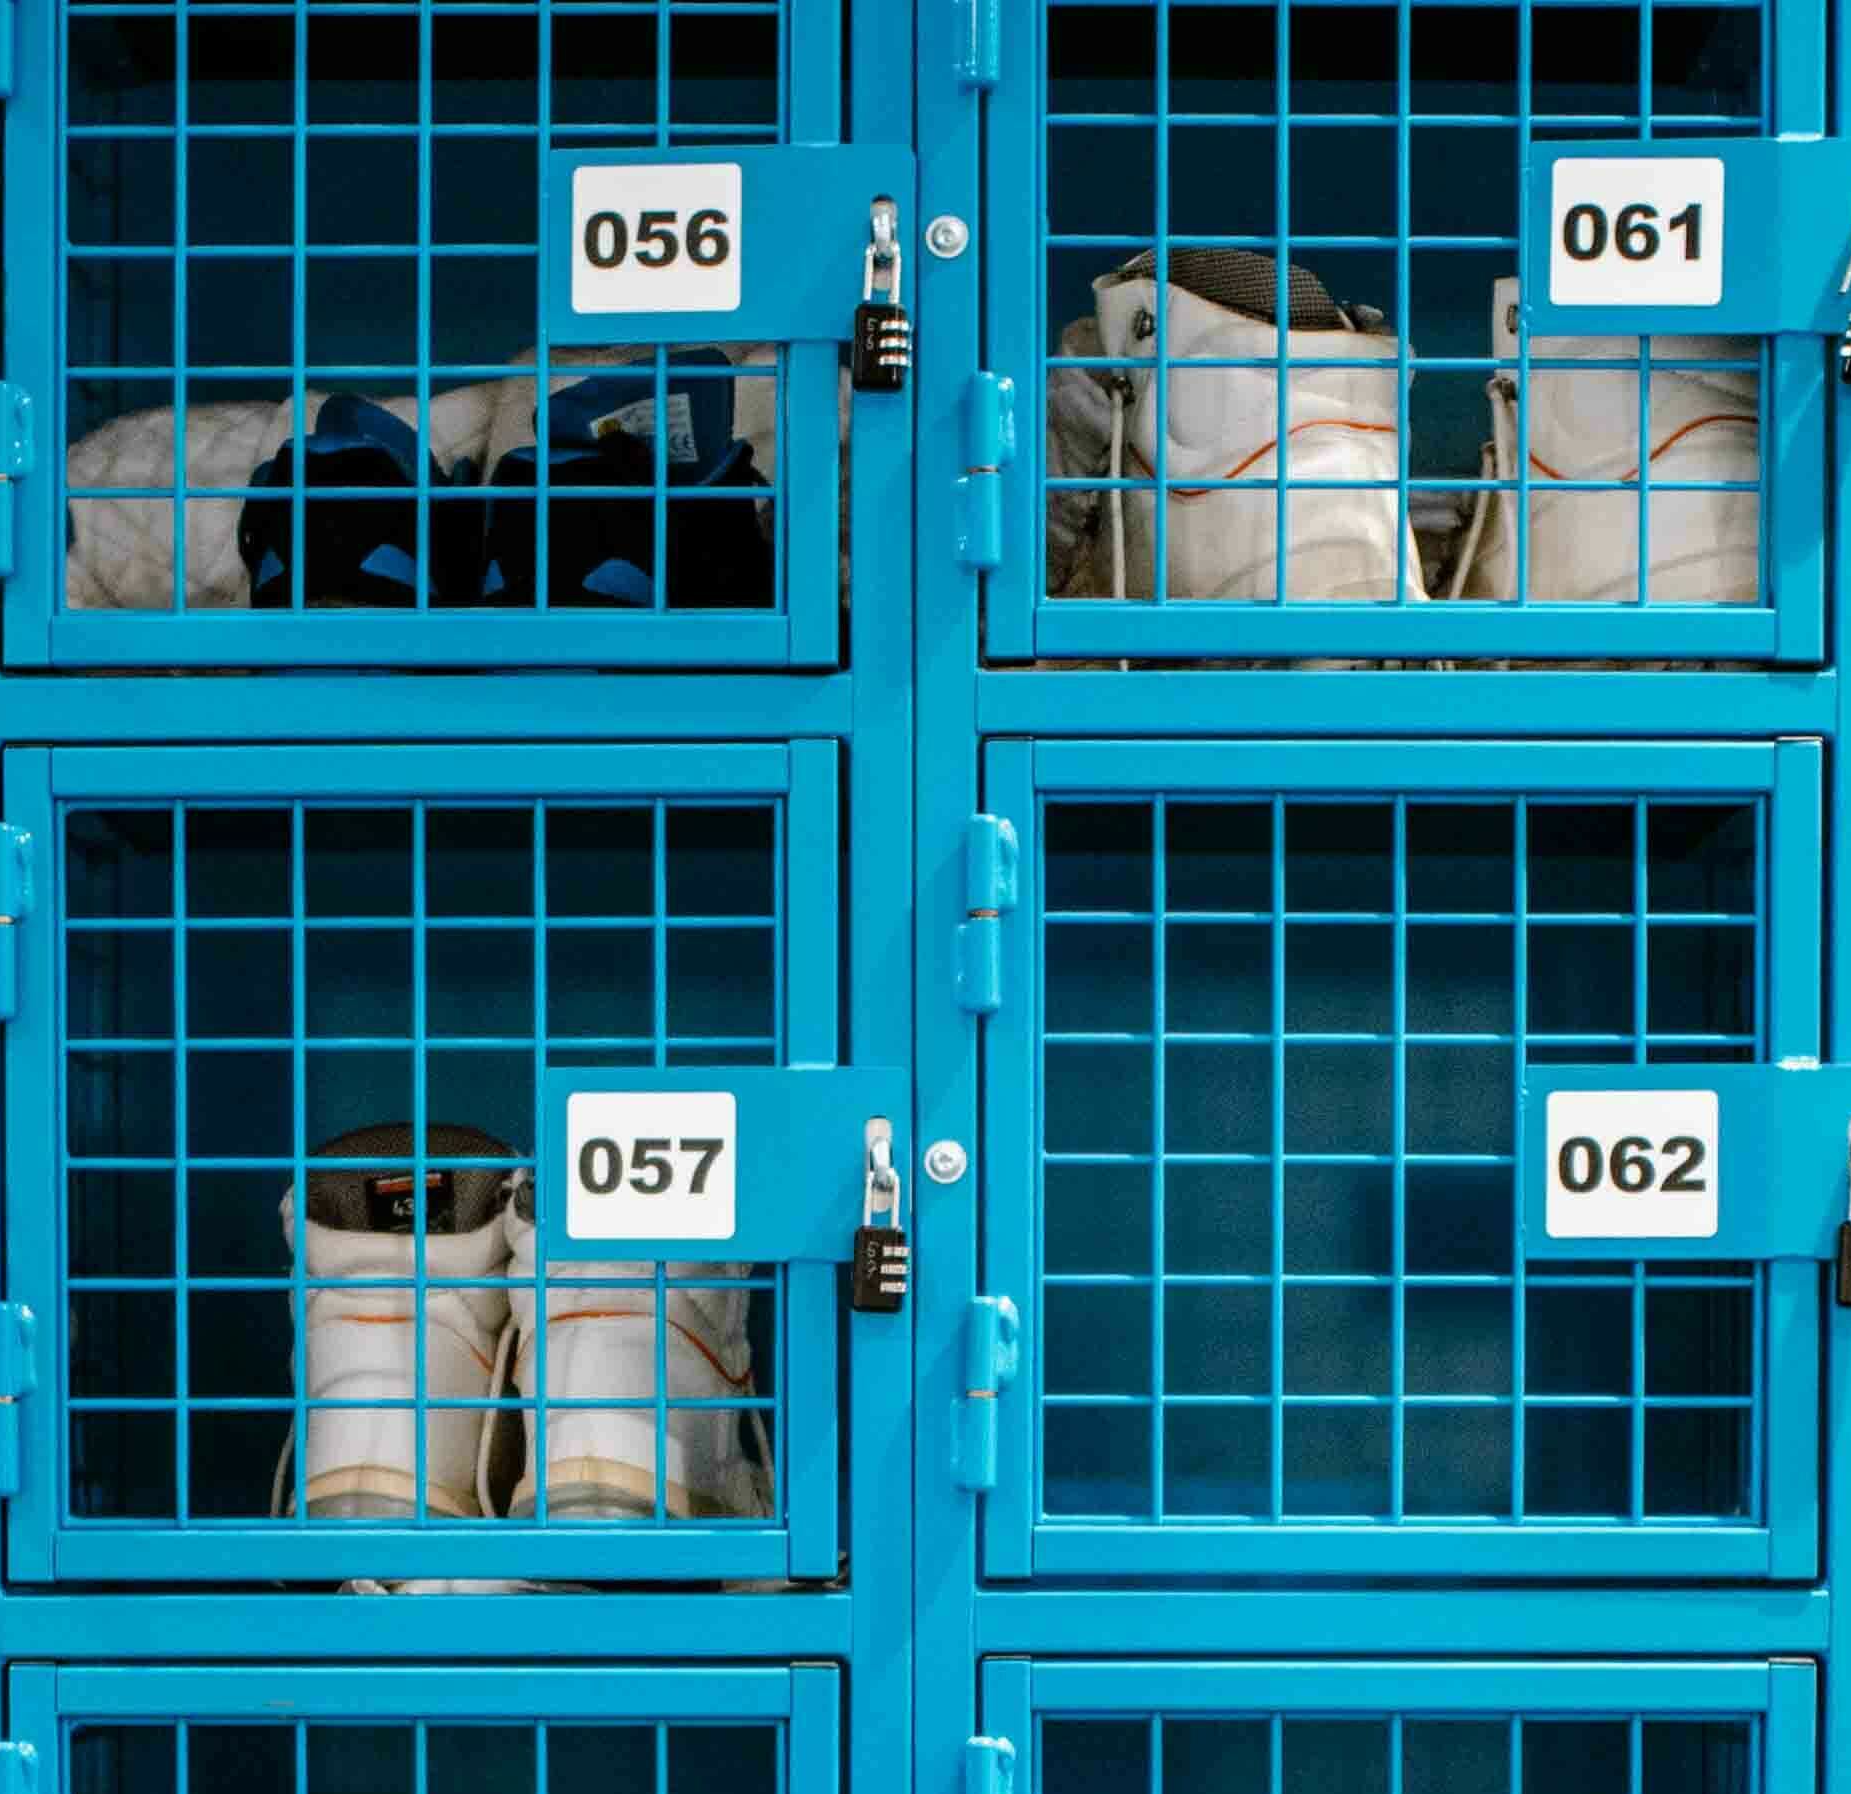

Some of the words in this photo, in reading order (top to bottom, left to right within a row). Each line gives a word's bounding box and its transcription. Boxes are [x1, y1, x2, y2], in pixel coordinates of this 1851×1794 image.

[583, 208, 730, 270] 056
[1562, 202, 1702, 262] 061
[578, 1137, 724, 1195] 057
[1557, 1136, 1706, 1194] 062
